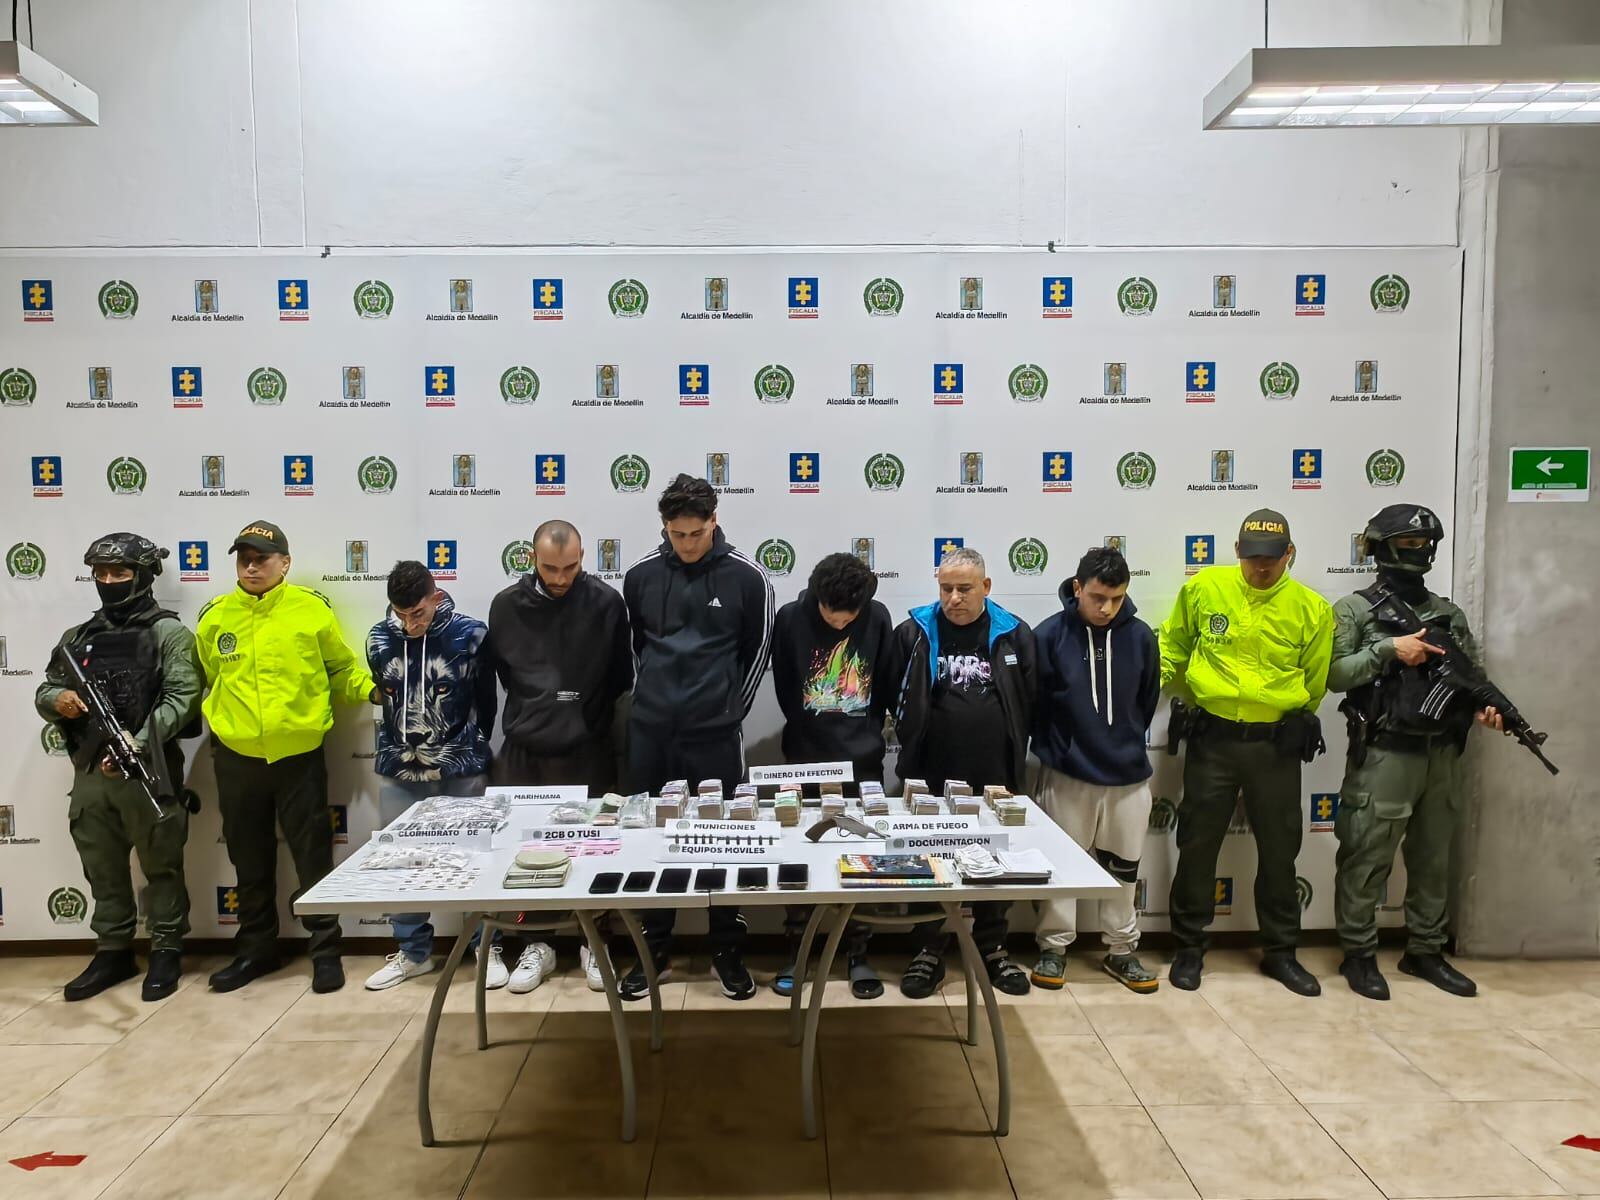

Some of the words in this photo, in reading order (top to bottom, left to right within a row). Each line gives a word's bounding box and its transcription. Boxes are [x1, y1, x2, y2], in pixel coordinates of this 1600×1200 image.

[1244, 521, 1284, 533] POLICIA
[240, 526, 274, 540] LICIA
[807, 769, 844, 777] EFECTIVO
[694, 823, 756, 831] MUNICIONES
[545, 831, 565, 839] 2CB
[568, 830, 575, 838] O
[576, 830, 601, 838] TUSI
[908, 837, 991, 848] DOCUMENTACION
[682, 846, 723, 854] EQUIPOS
[725, 846, 766, 854] MOVILES
